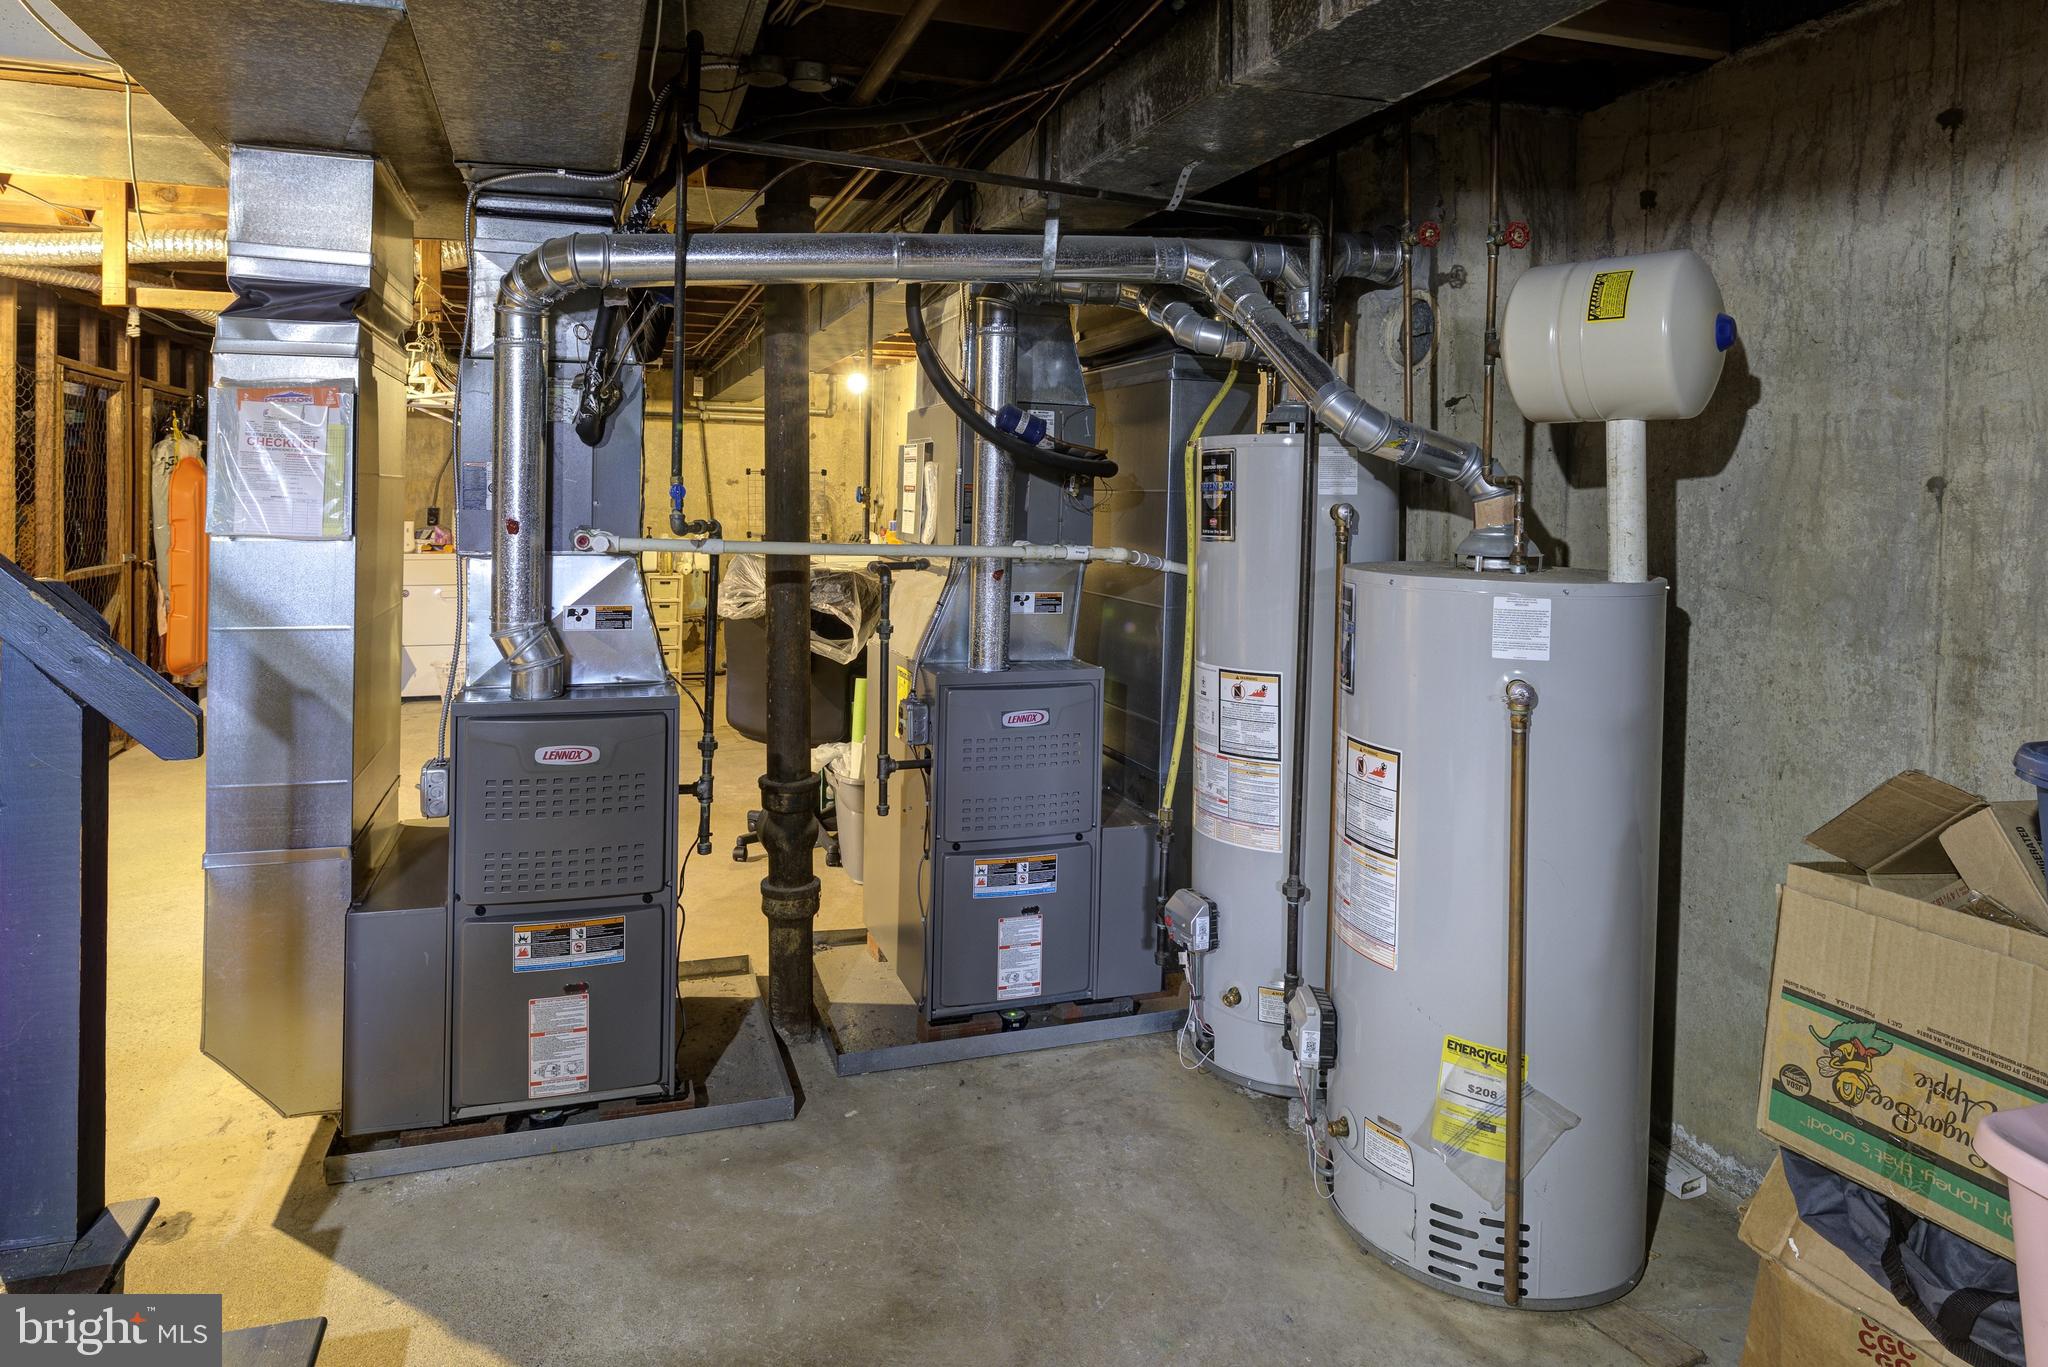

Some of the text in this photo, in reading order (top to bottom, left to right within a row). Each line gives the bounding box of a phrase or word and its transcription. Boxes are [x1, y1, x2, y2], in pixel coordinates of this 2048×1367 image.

[247, 437, 318, 449] CHECKLIST
[1007, 713, 1038, 724] LENNOX
[542, 750, 583, 761] LENNOX
[1467, 1084, 1498, 1100] $208
[1786, 1079, 1804, 1093] USDA
[1914, 1072, 1998, 1124] Apple
[1861, 1141, 1913, 1178] that's
